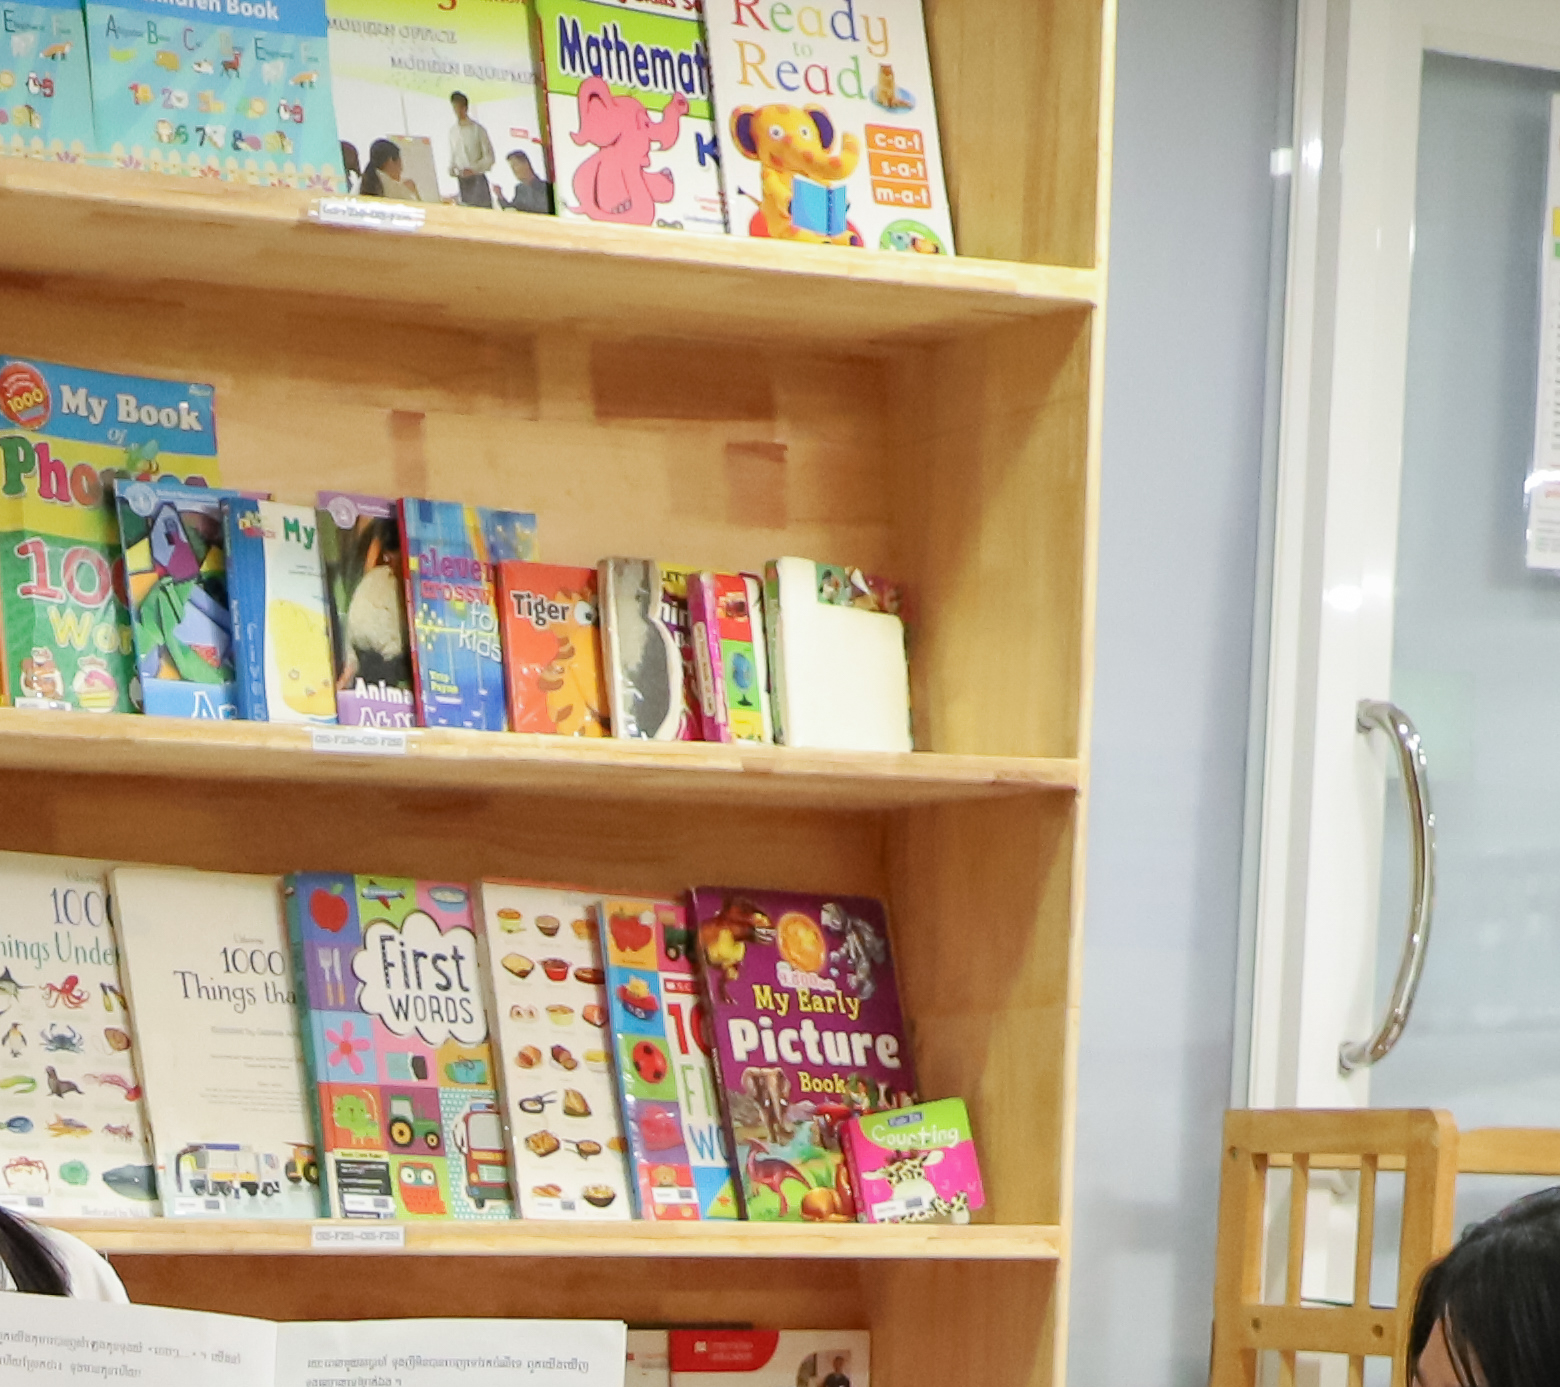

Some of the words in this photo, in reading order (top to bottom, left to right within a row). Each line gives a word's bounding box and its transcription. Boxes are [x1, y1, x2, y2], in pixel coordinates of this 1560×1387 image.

[226, 0, 279, 21] Book
[731, 0, 889, 58] Ready
[792, 41, 814, 59] to
[733, 39, 870, 100] Read
[874, 131, 923, 151] c-a-t
[881, 159, 926, 178] s-a-t
[875, 188, 929, 205] m-a-t
[60, 385, 109, 426] My
[117, 394, 203, 432] Book
[283, 516, 316, 550] My
[512, 593, 571, 627] Tiger
[459, 621, 501, 663] kids
[220, 946, 286, 976] 1000
[379, 933, 470, 993] First
[173, 970, 257, 1014] Things
[752, 985, 789, 1018] My
[795, 988, 861, 1021] Early
[388, 994, 475, 1026] WORDS
[727, 1016, 901, 1070] Picture
[797, 1070, 847, 1095] Book
[871, 1115, 959, 1149] Counting
